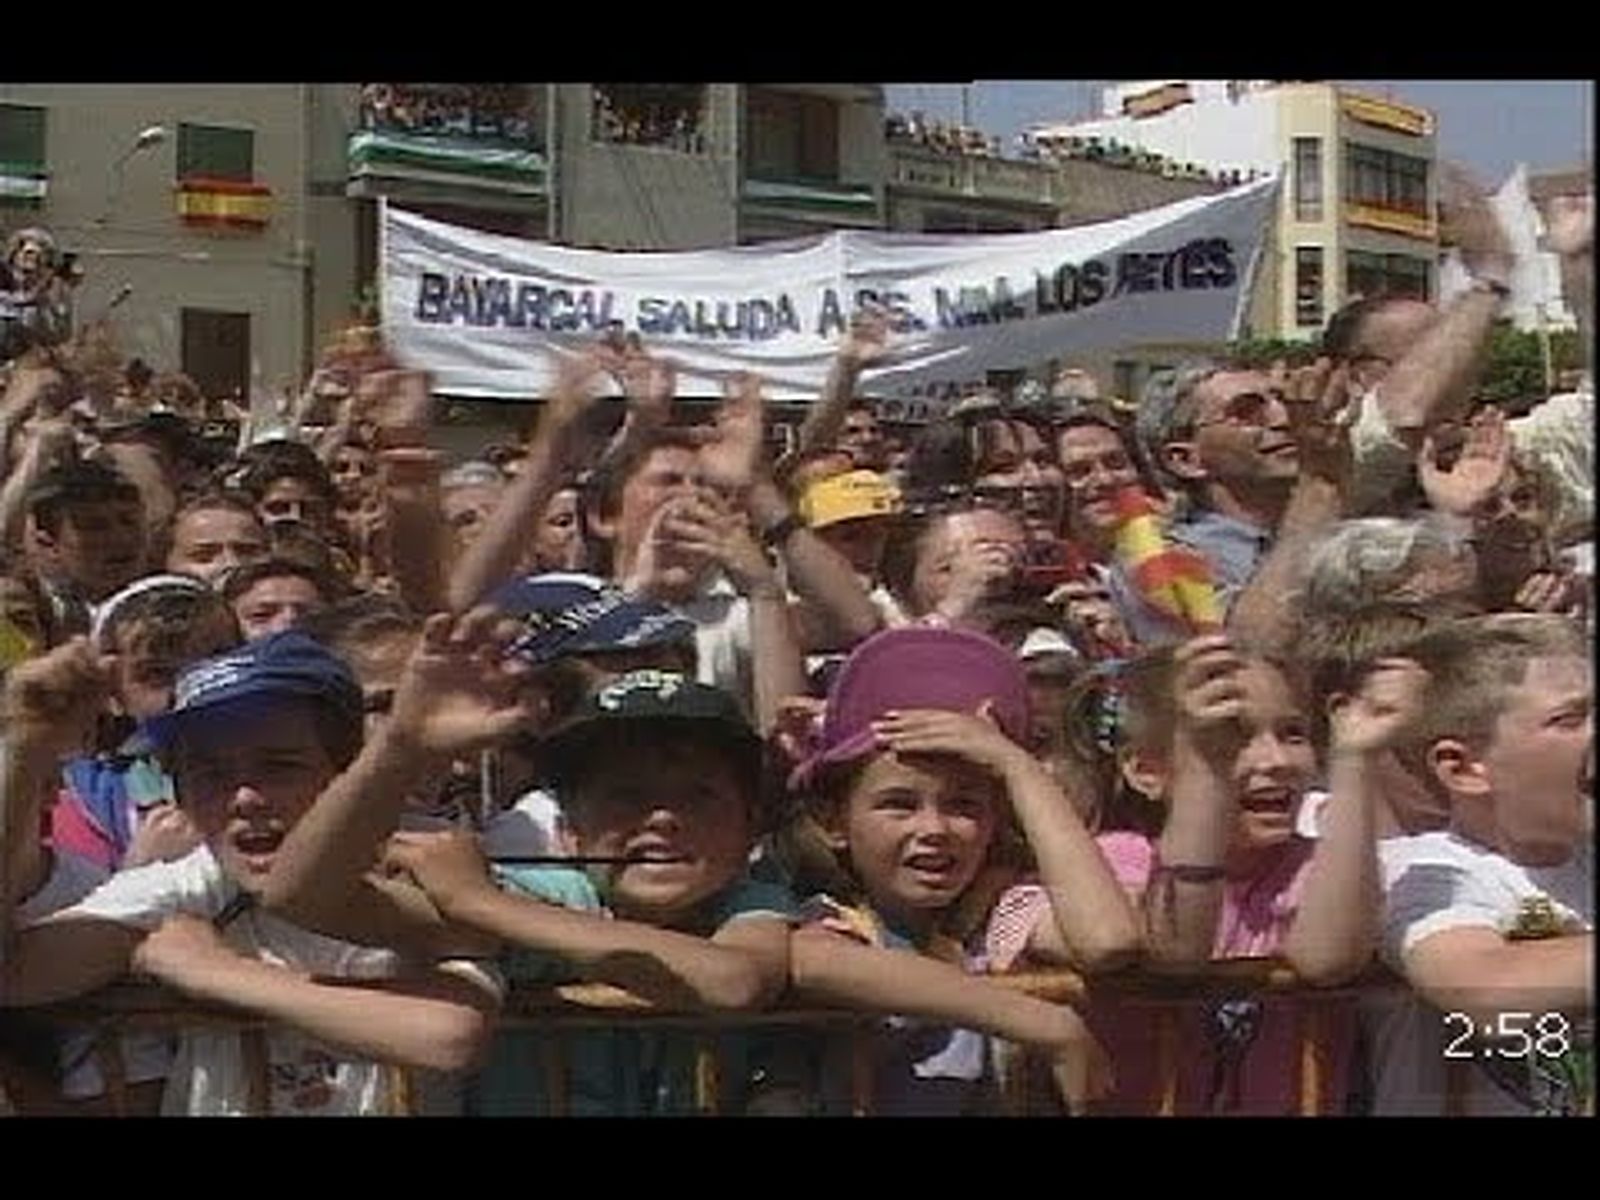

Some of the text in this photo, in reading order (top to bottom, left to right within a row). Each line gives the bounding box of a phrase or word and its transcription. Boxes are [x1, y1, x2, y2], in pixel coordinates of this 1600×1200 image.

[636, 295, 799, 340] SALUDA
[817, 288, 846, 339] A
[1035, 262, 1109, 315] LOS
